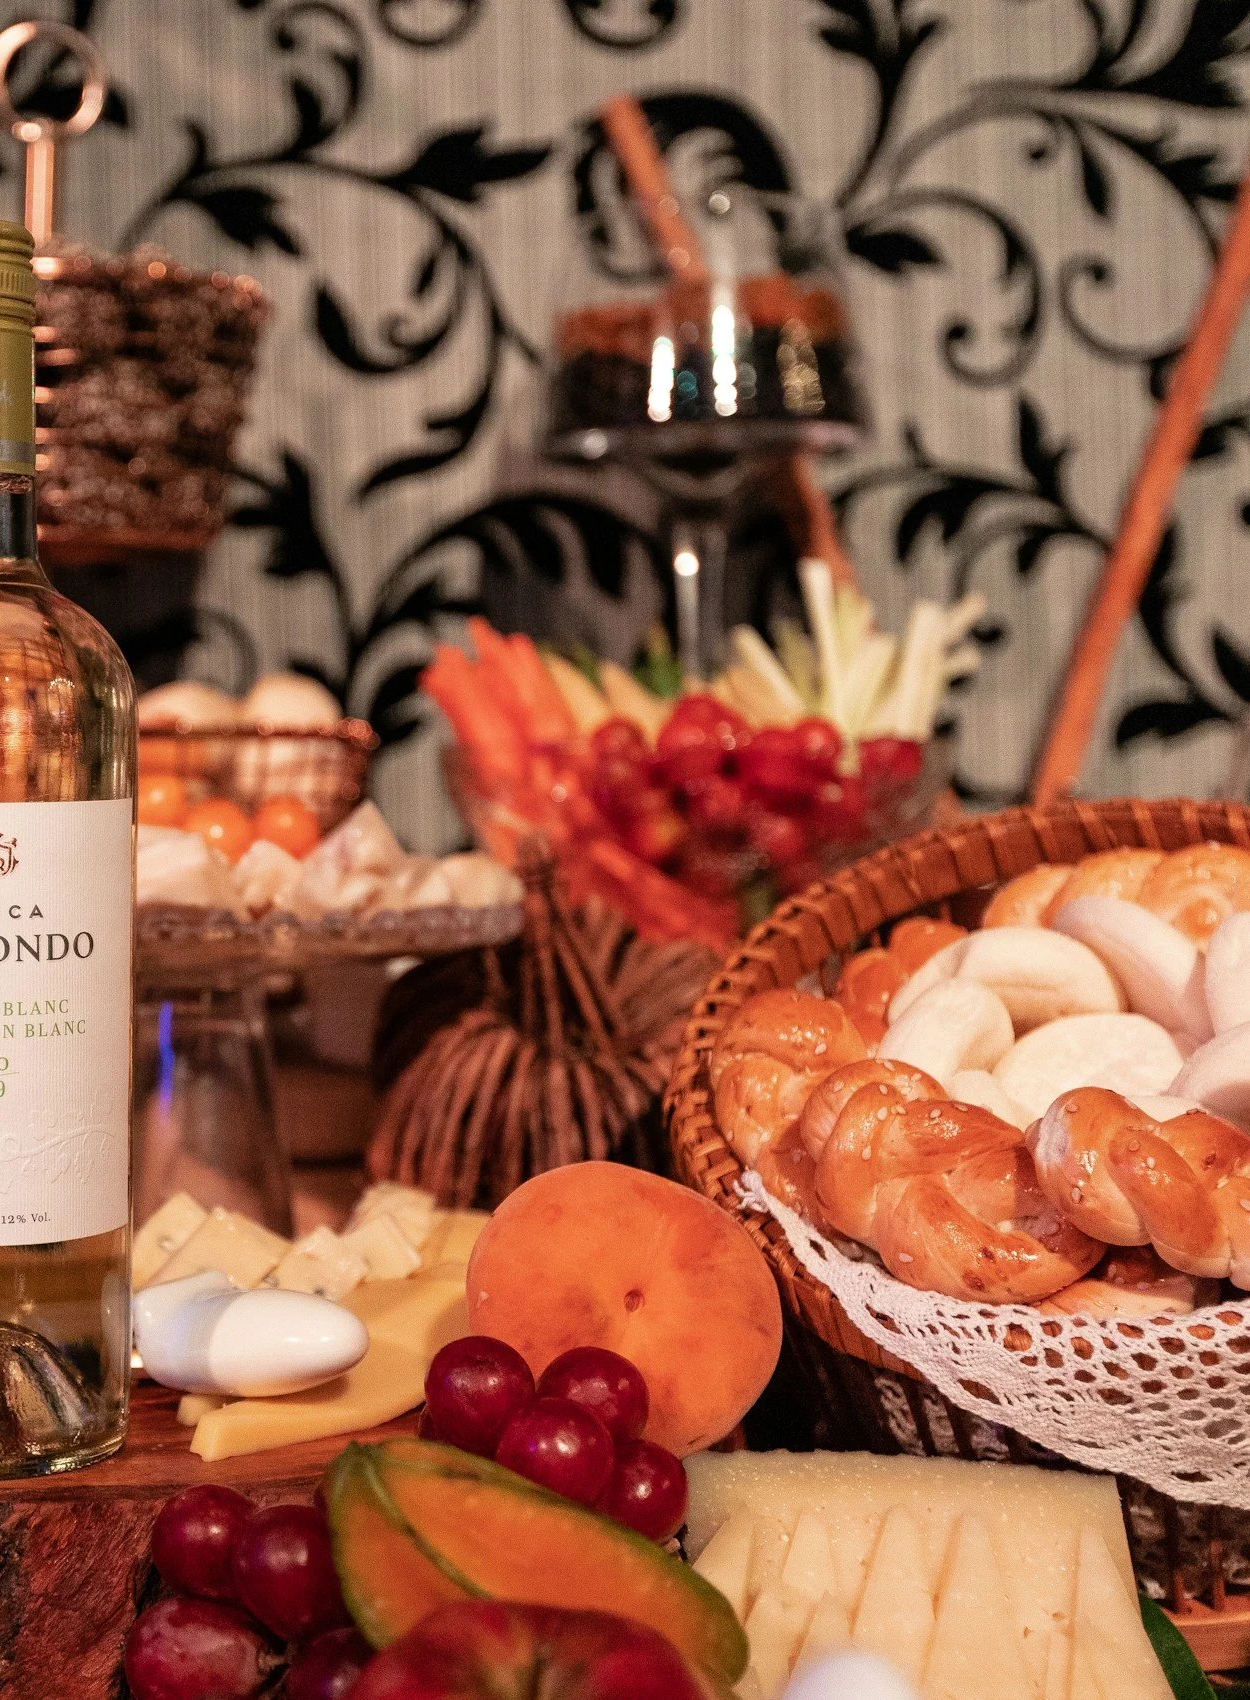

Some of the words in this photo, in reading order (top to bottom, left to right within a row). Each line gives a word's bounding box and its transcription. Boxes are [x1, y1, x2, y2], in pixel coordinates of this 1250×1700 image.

[3, 999, 69, 1017] BLANC
[24, 1019, 87, 1038] BLANC
[1, 1214, 27, 1225] 12%
[31, 1211, 51, 1223] Vol.
